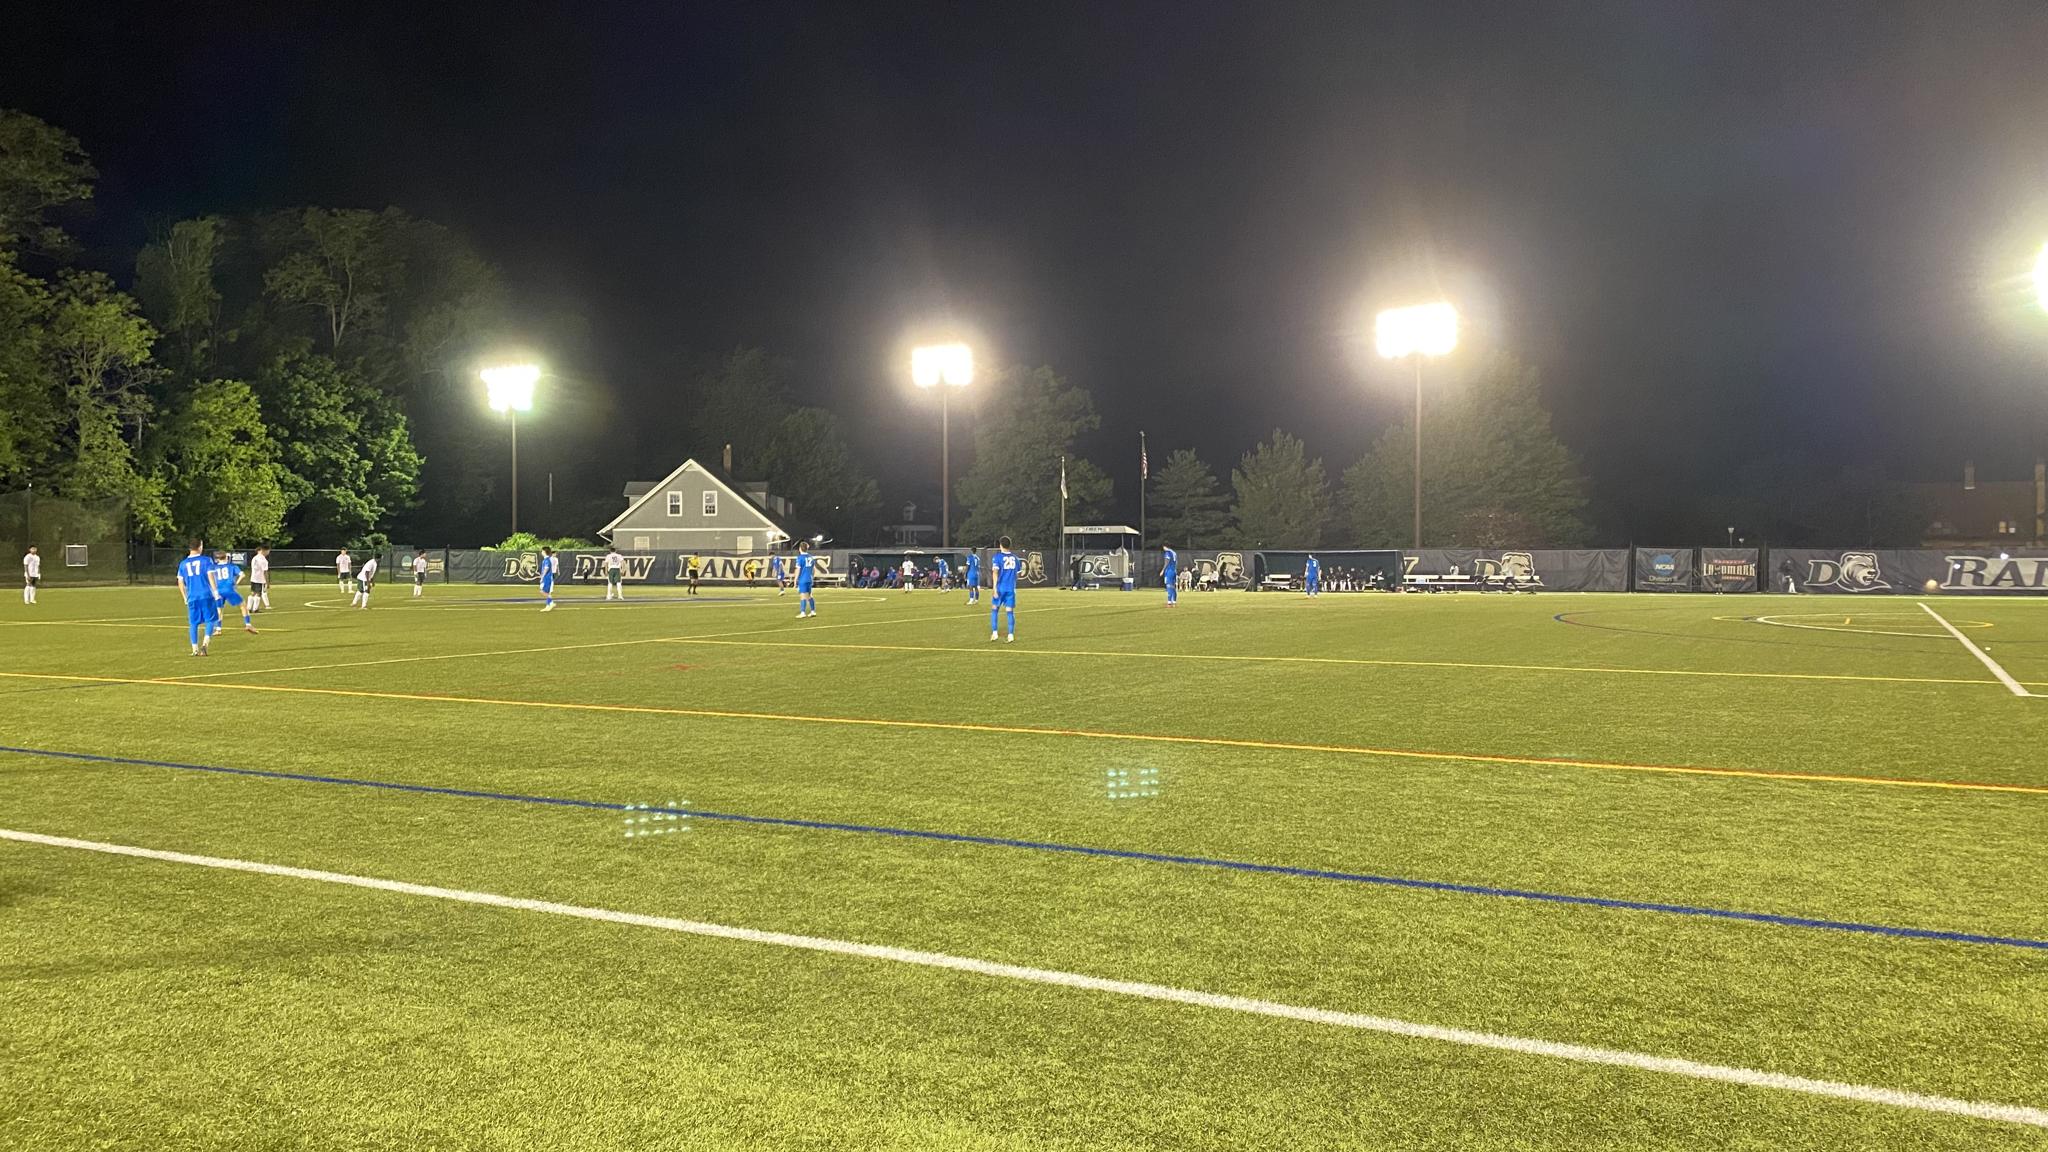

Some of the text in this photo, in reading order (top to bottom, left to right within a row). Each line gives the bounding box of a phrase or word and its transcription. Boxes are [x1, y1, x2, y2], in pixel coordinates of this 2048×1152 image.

[186, 560, 200, 576] 17
[574, 555, 830, 580] DW ANGS
[1003, 556, 1015, 569] 26
[216, 566, 229, 580] 18
